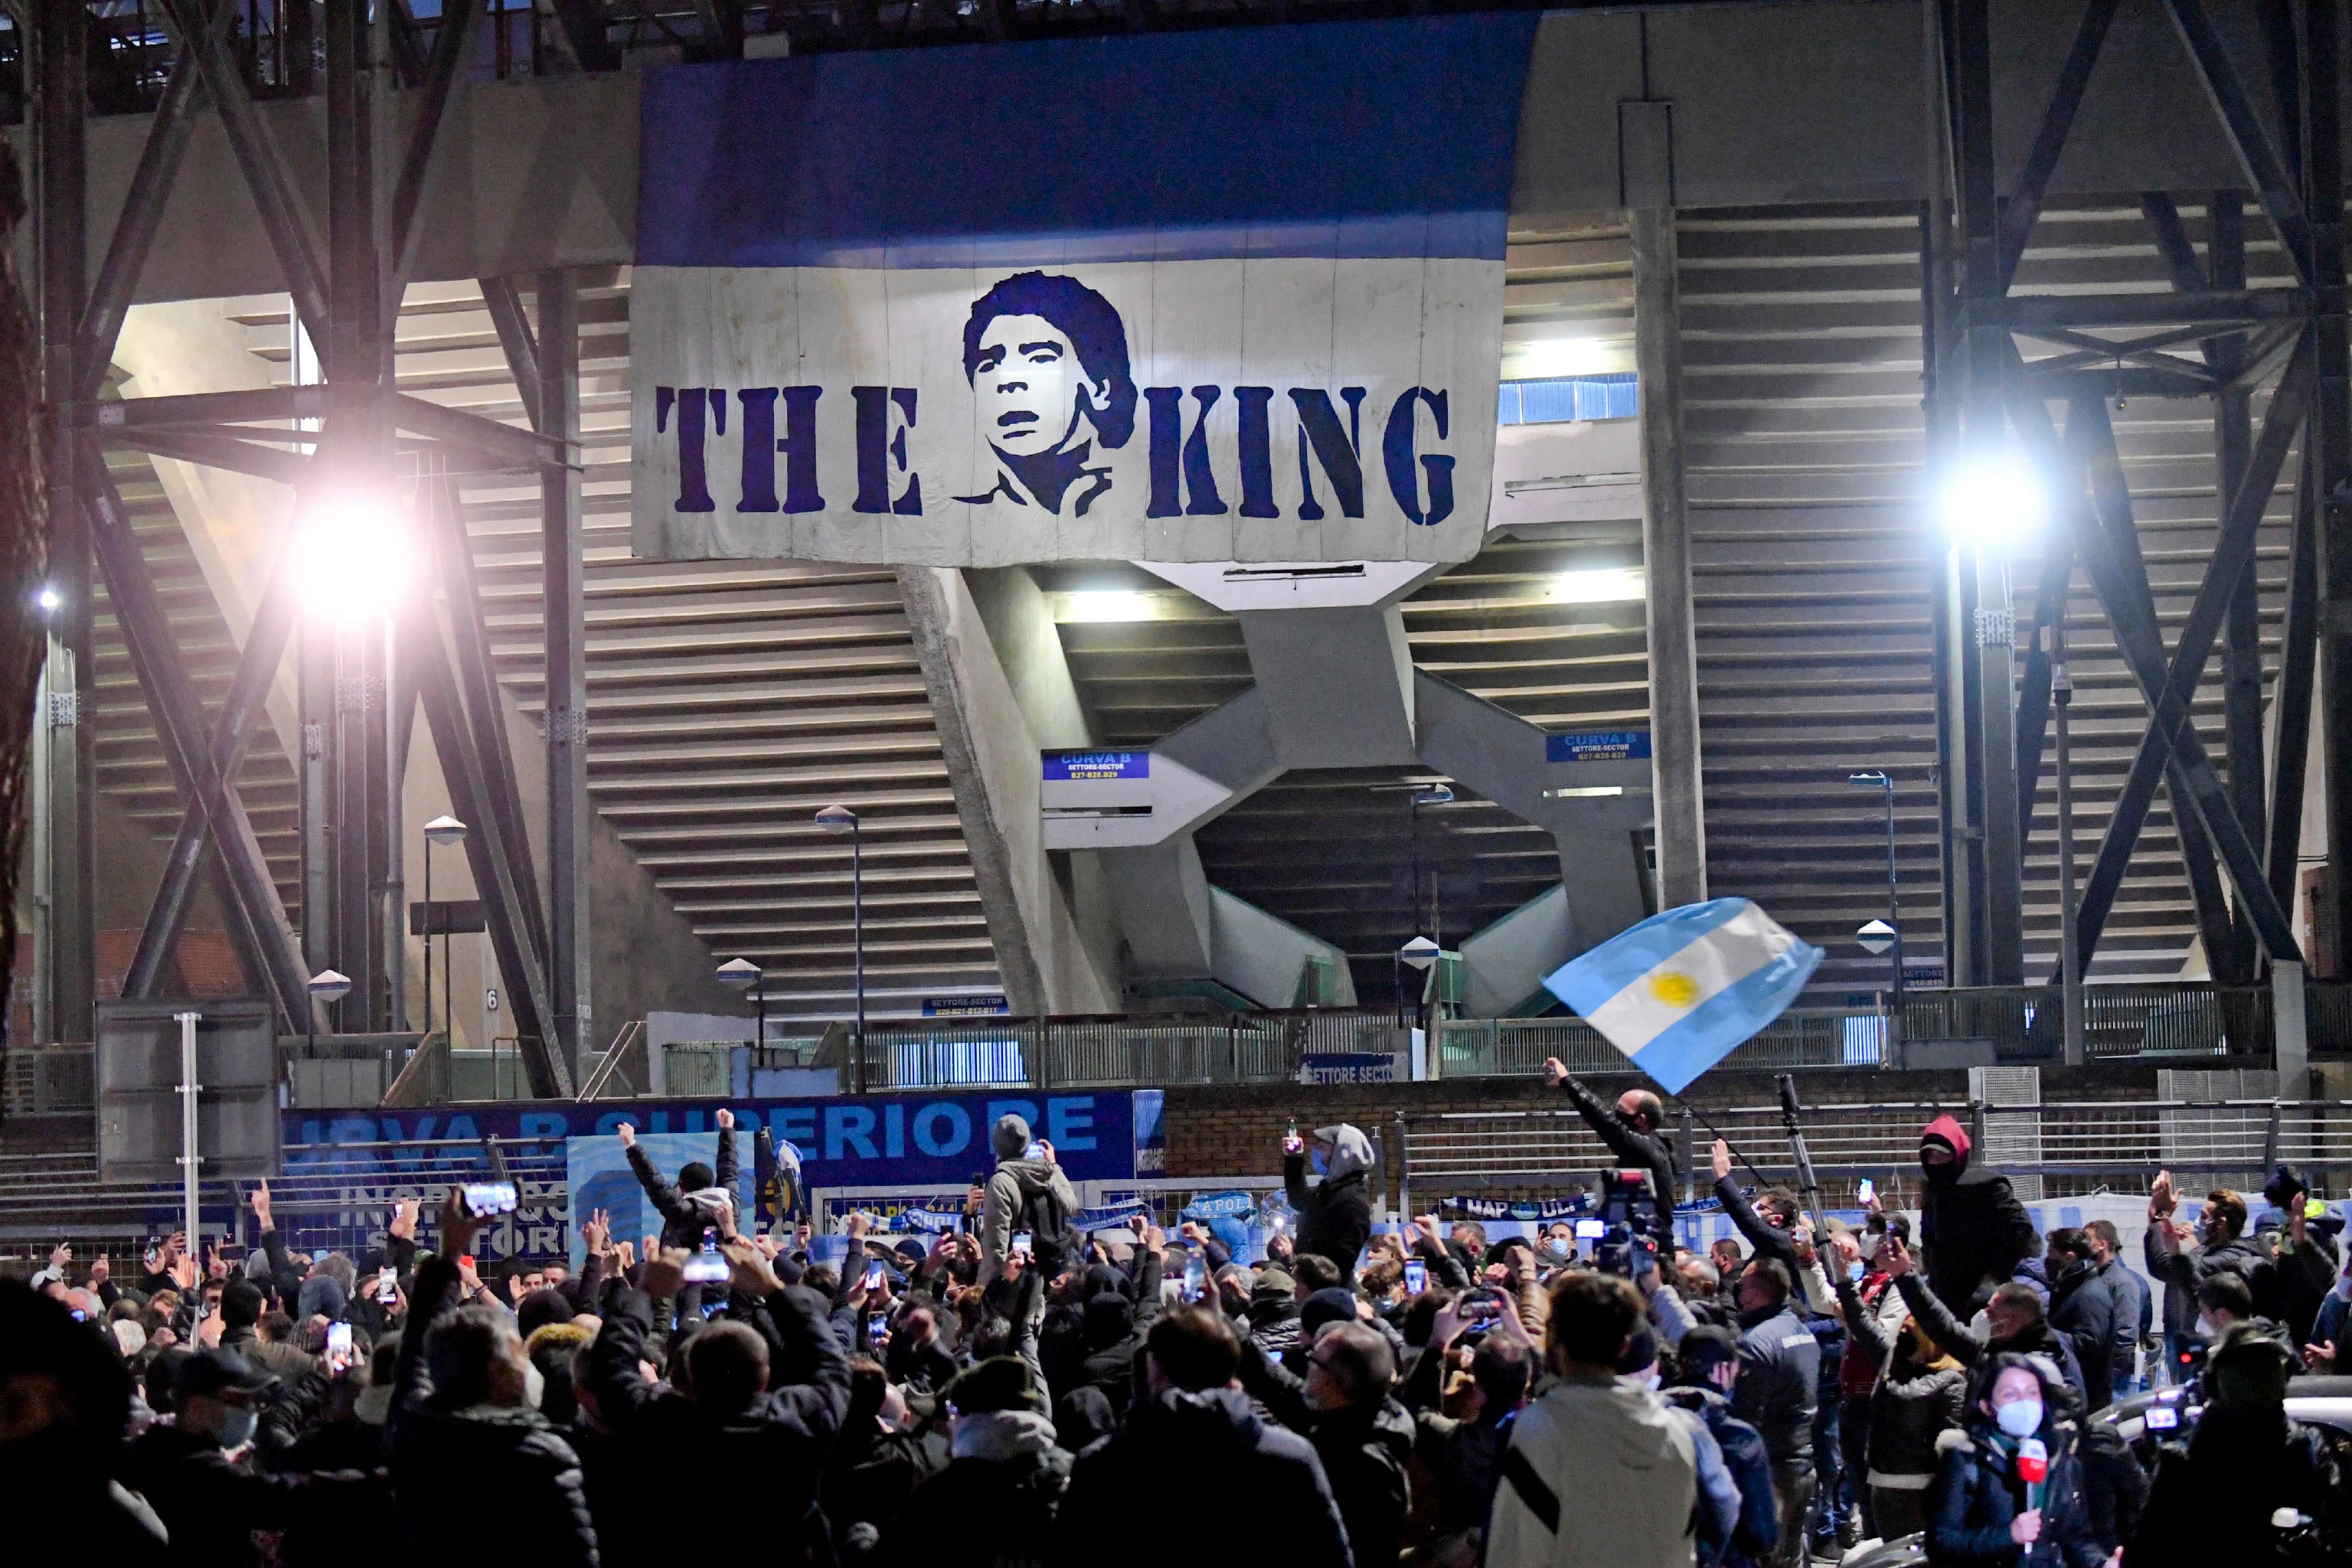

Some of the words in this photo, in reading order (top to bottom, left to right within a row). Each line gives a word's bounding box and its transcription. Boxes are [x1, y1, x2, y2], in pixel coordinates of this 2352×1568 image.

[655, 385, 923, 517] THE
[1144, 385, 1455, 527] KING
[1564, 733, 1620, 746] CURVA
[1061, 753, 1116, 764] CURVA
[1120, 753, 1132, 763] B
[1068, 763, 1125, 771] SETTORE-SECTOR
[488, 990, 497, 1009] 6
